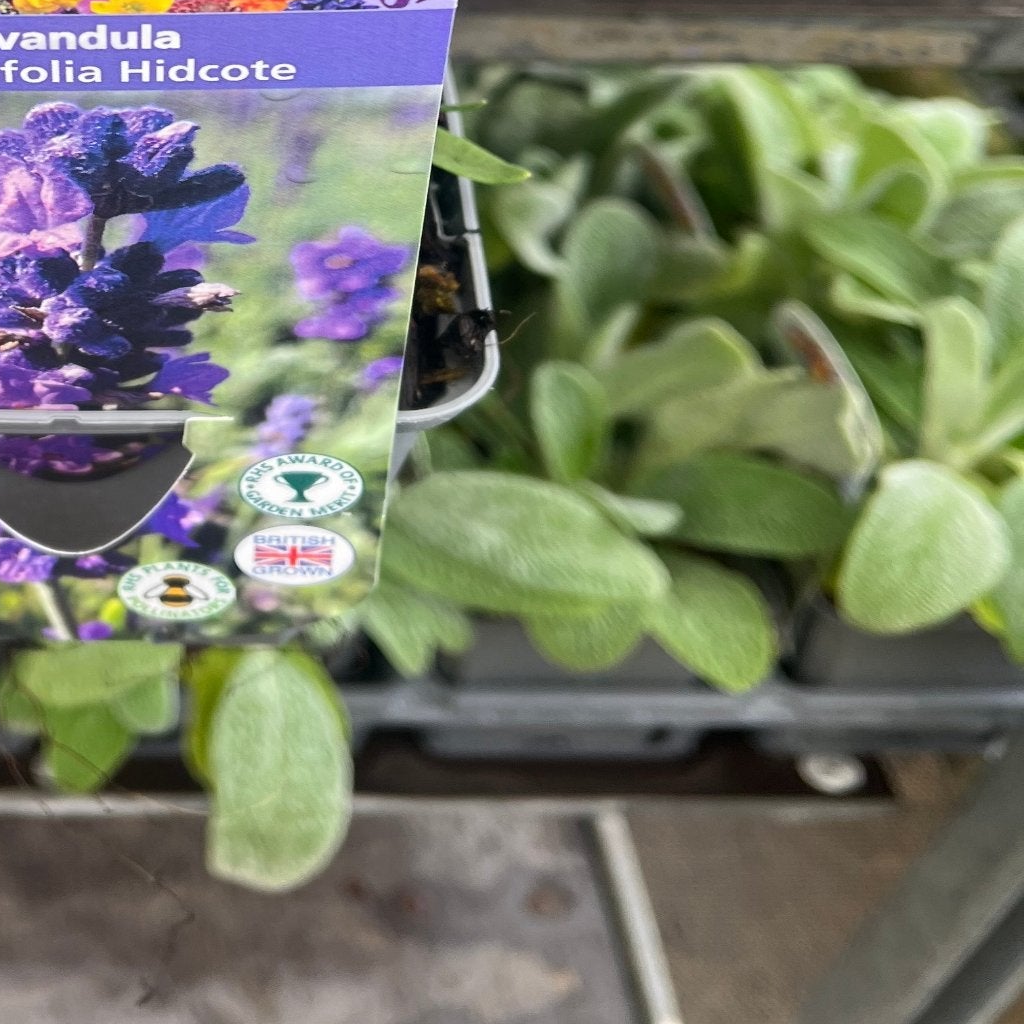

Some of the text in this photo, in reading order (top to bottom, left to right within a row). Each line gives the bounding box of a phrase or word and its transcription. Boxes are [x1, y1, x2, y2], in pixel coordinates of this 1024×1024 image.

[120, 58, 297, 82] Hidcote
[245, 455, 359, 484] RHS AWARD OF
[246, 489, 356, 516] GARDEN MERIT
[253, 534, 335, 546] BRITISH
[252, 565, 334, 577] GROWN
